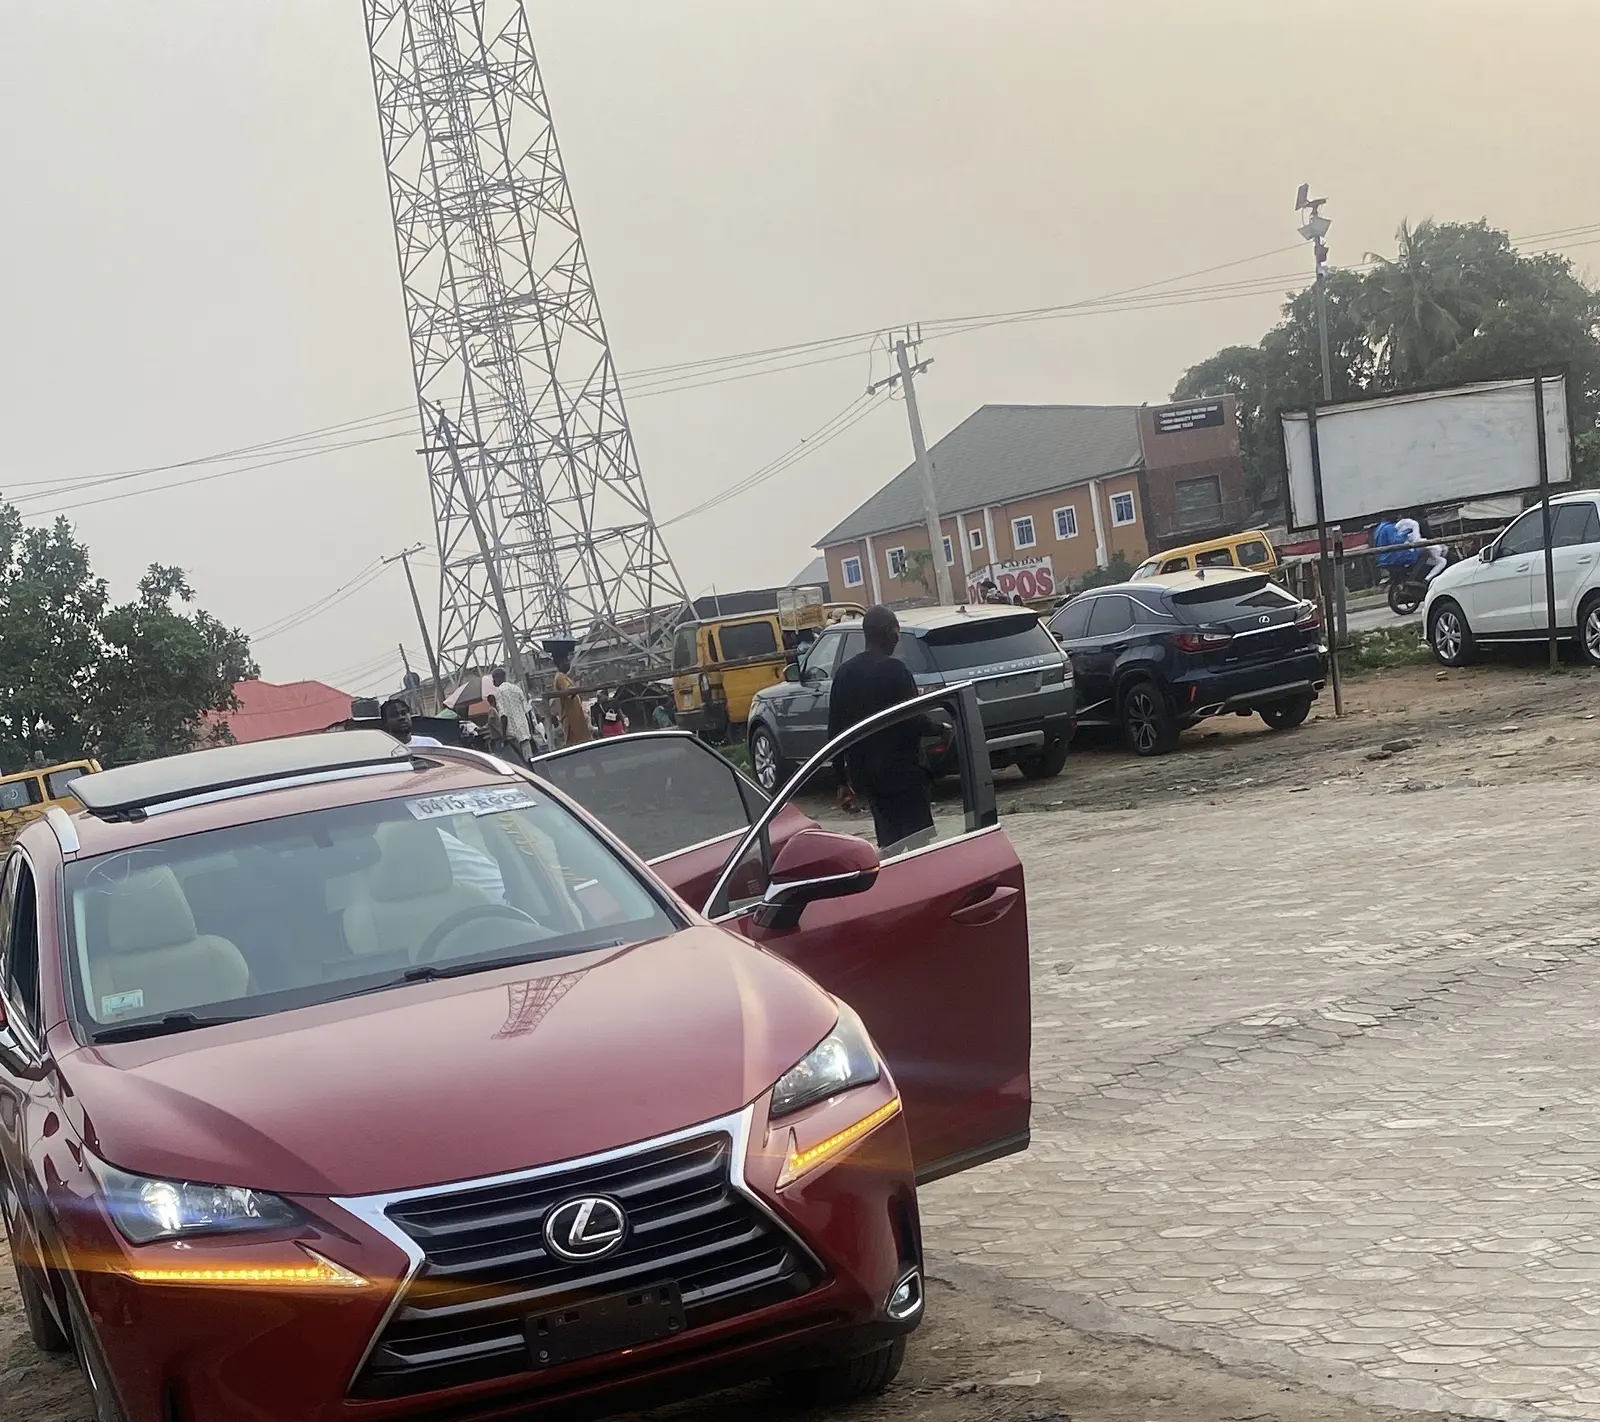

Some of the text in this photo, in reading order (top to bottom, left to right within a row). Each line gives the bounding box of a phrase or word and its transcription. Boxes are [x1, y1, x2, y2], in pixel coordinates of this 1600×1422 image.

[997, 567, 1054, 599] POS
[968, 659, 1044, 676] RANGE ROVER
